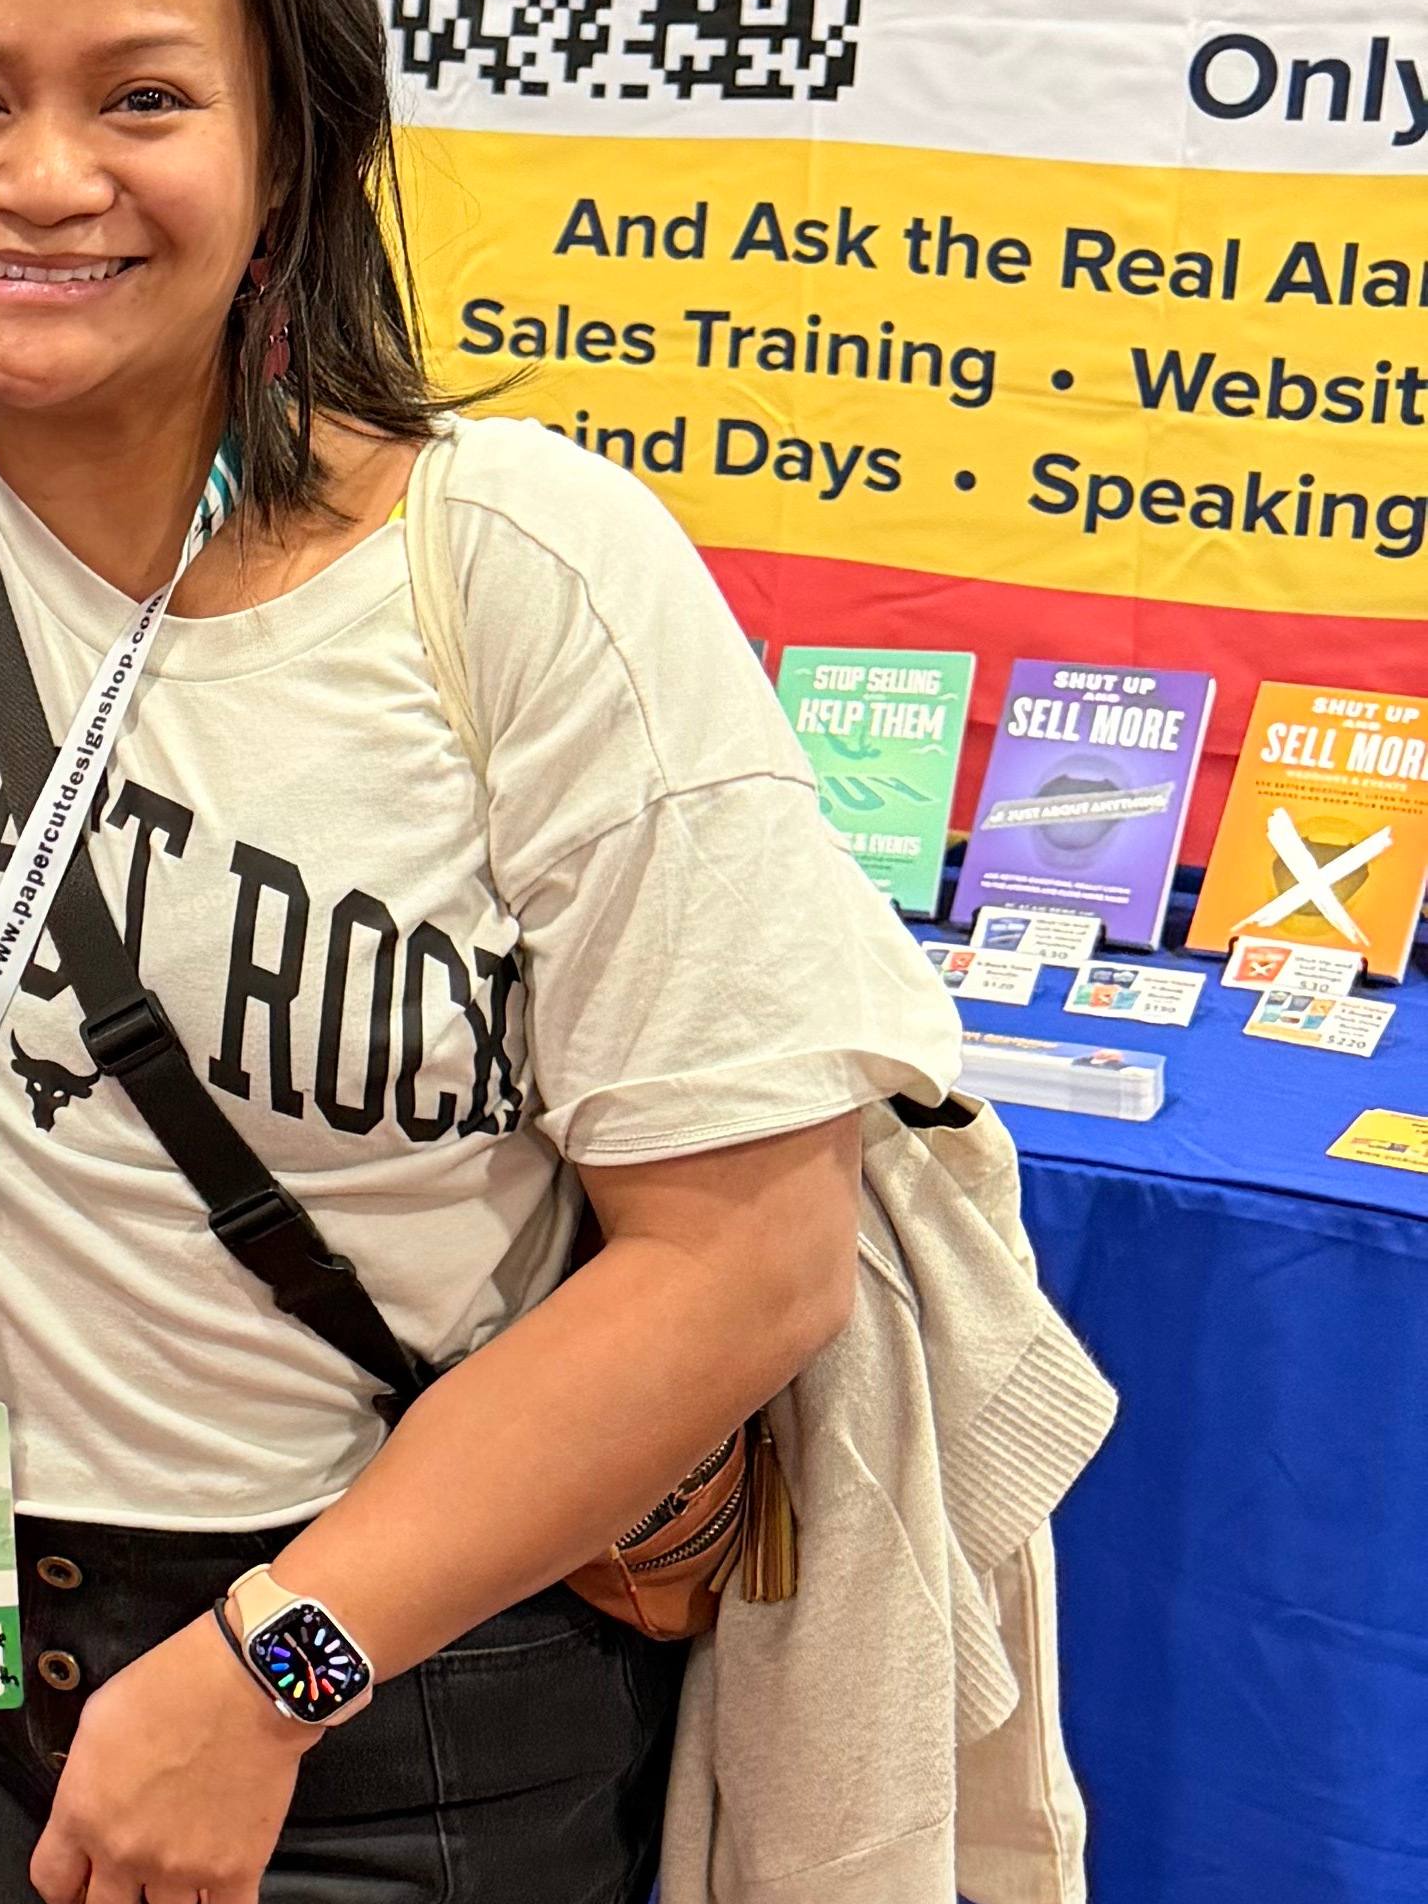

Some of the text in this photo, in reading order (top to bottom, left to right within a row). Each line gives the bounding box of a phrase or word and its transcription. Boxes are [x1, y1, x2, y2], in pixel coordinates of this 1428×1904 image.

[1188, 33, 1428, 147] Only
[553, 197, 1428, 309] And Ask the Real Ala
[457, 298, 657, 367] Sales
[683, 309, 997, 409] Training
[544, 409, 1428, 559] ind Days Speaking
[813, 664, 943, 696] STOP SELLING
[1053, 670, 1156, 695] SHUT UP
[1311, 696, 1421, 725] SHUT UP
[796, 697, 946, 740] HELP THEM
[1007, 696, 1185, 752] SELL MORE
[1259, 721, 1337, 770] SELL
[1346, 731, 1428, 782] MOR
[209, 841, 525, 1143] ROCK
